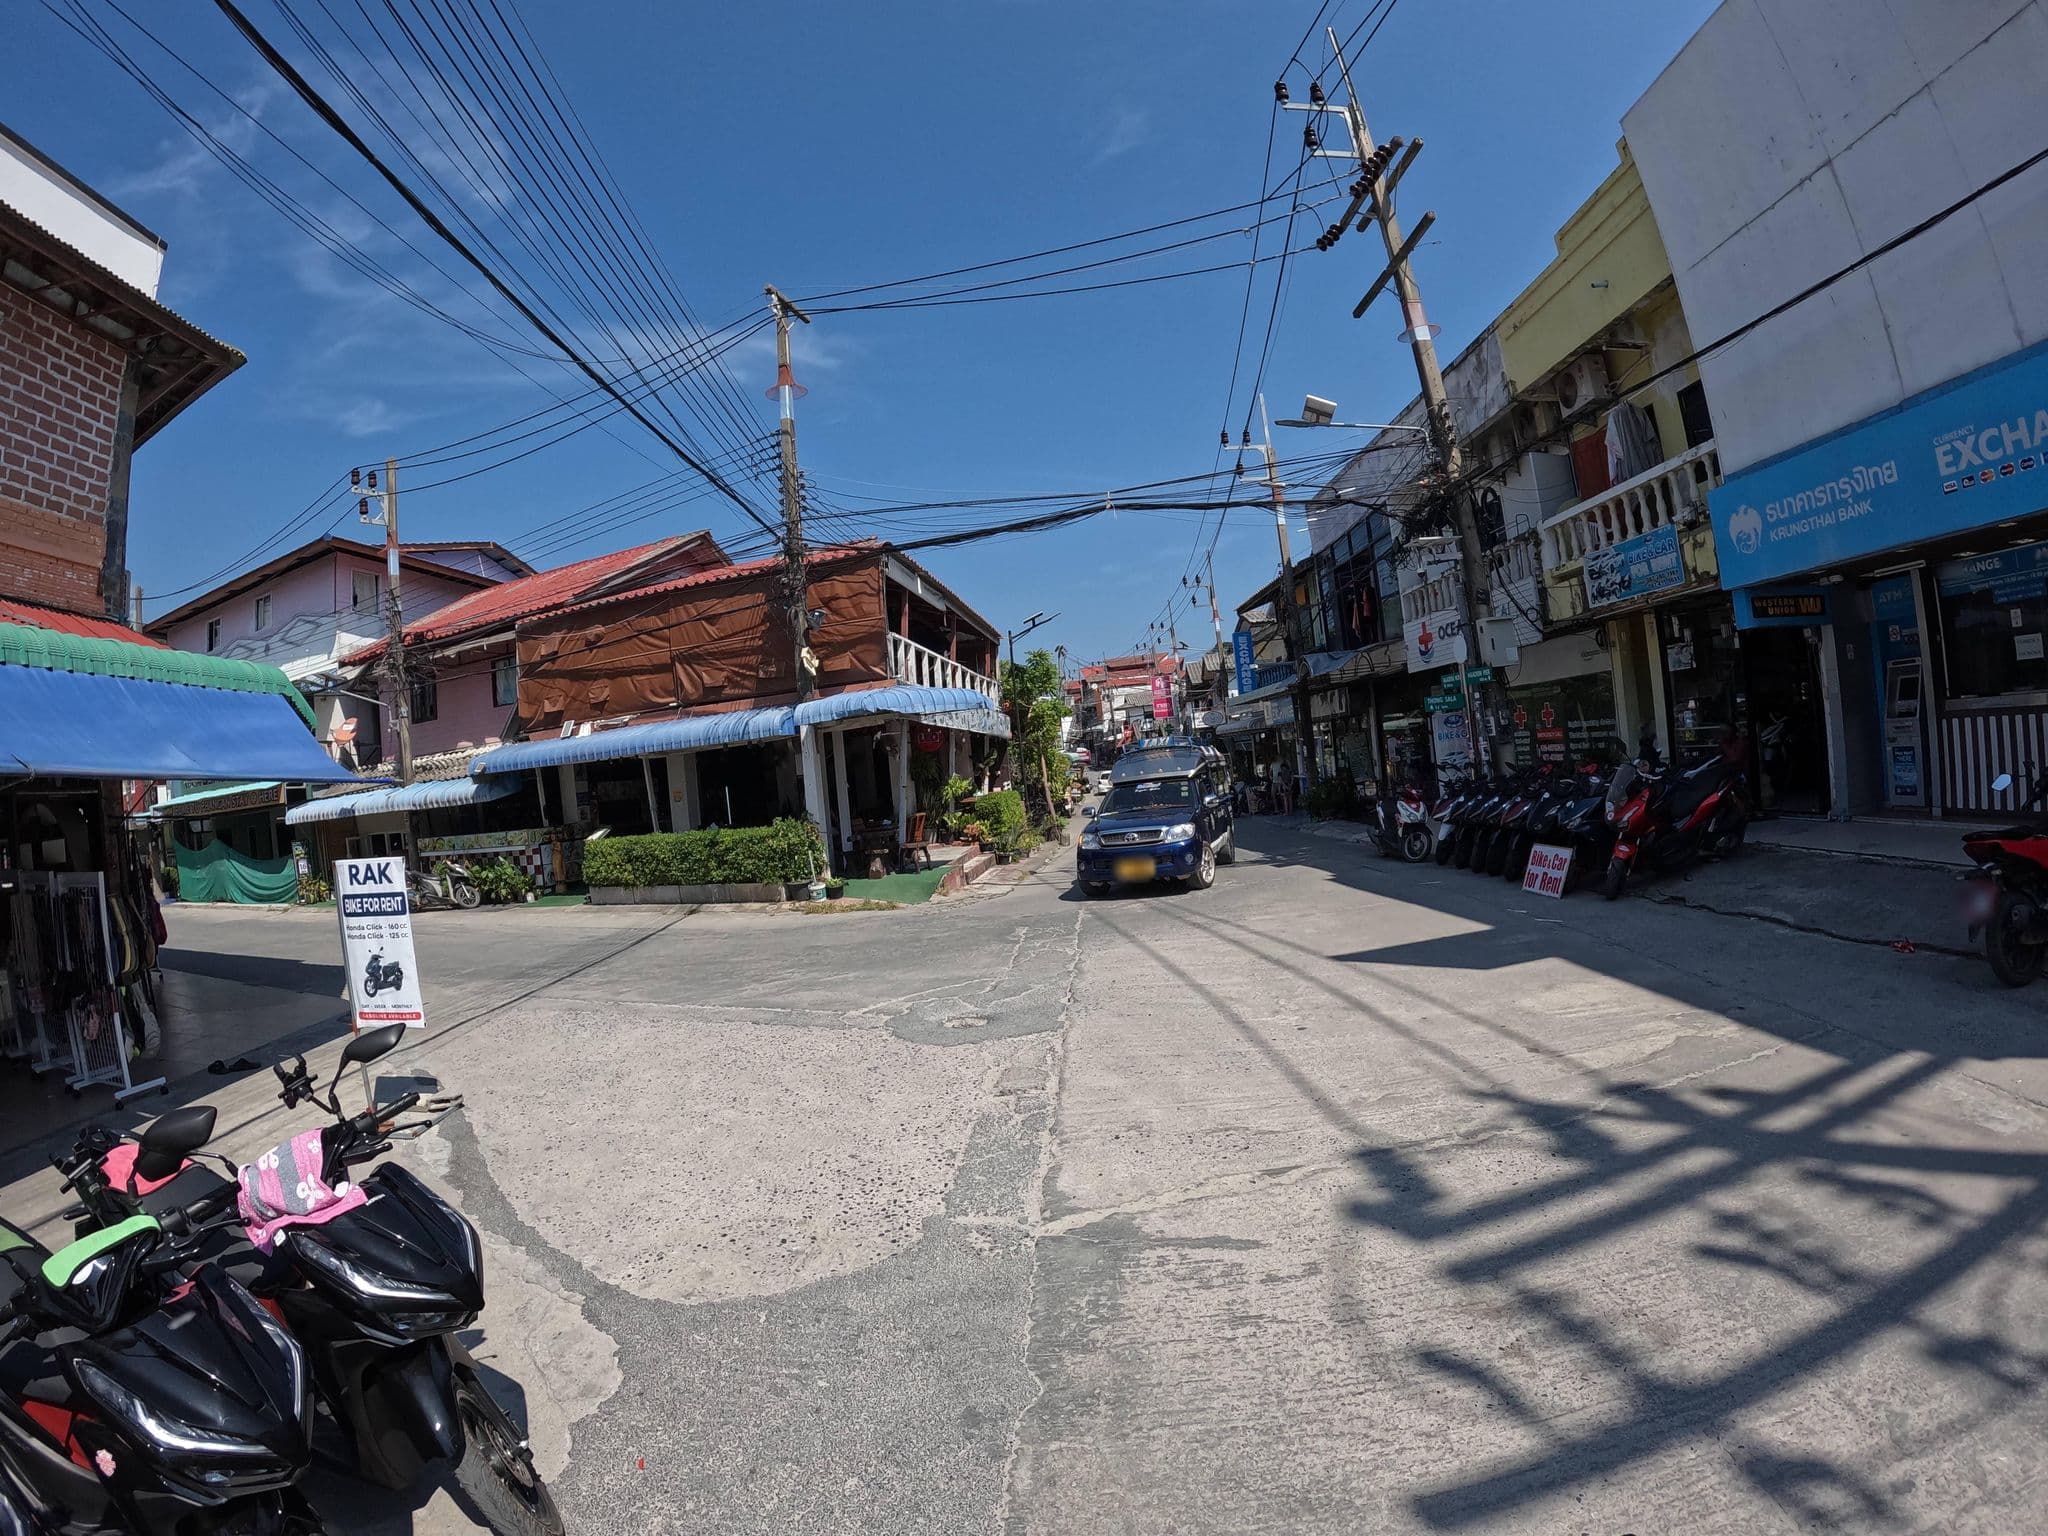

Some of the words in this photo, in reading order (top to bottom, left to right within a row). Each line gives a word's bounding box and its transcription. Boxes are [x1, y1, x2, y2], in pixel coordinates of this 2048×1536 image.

[1932, 424, 1975, 446] CURRENCY
[1765, 460, 1899, 523] ธนาคารกรุงไทย
[1769, 514, 1836, 542] KRUNGTHAI
[1838, 499, 1873, 523] BANK
[1754, 597, 1795, 607] WESTERN
[1767, 606, 1793, 615] UNION
[1238, 636, 1252, 693] EXCHANGE
[259, 788, 279, 802] HERE
[348, 862, 394, 886] RAK
[1539, 872, 1563, 894] Rent
[345, 898, 362, 913] BIKE
[362, 897, 380, 912] FOR
[381, 896, 403, 911] RENT
